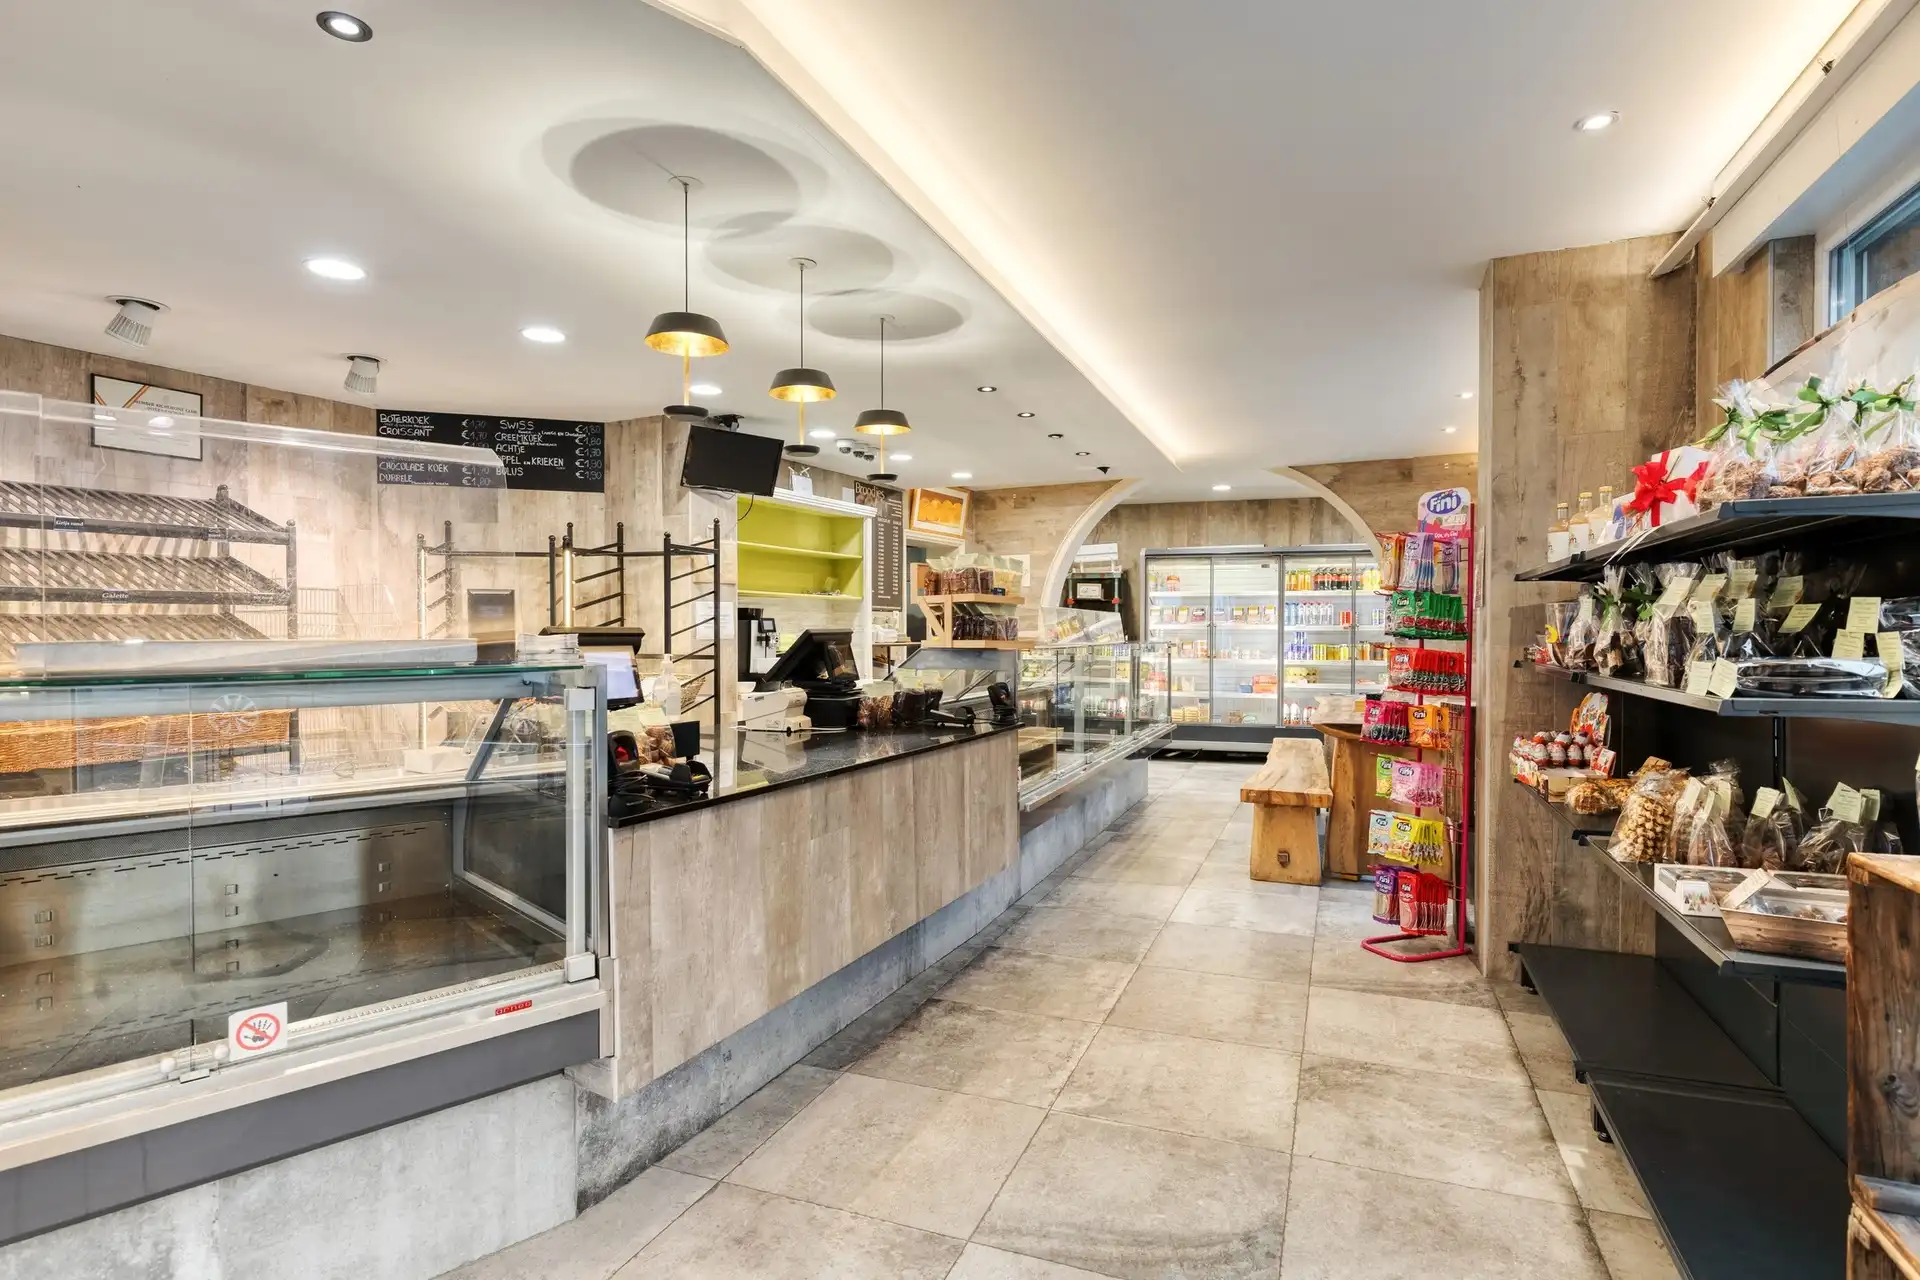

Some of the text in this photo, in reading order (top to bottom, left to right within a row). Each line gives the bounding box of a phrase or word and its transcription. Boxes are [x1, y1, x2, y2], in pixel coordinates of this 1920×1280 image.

[379, 413, 430, 425] BOTERKOEK
[499, 419, 535, 431] SWISS
[378, 425, 433, 437] CROISSANT
[498, 454, 522, 465] PPEL
[531, 456, 564, 467] KRIEKEN
[378, 461, 425, 472] CHOCOLADE
[427, 463, 450, 473] KOEK
[495, 466, 524, 477] BOLUS
[855, 481, 886, 500] Broodjes
[1429, 490, 1459, 513] Fini
[1413, 711, 1427, 720] Fini
